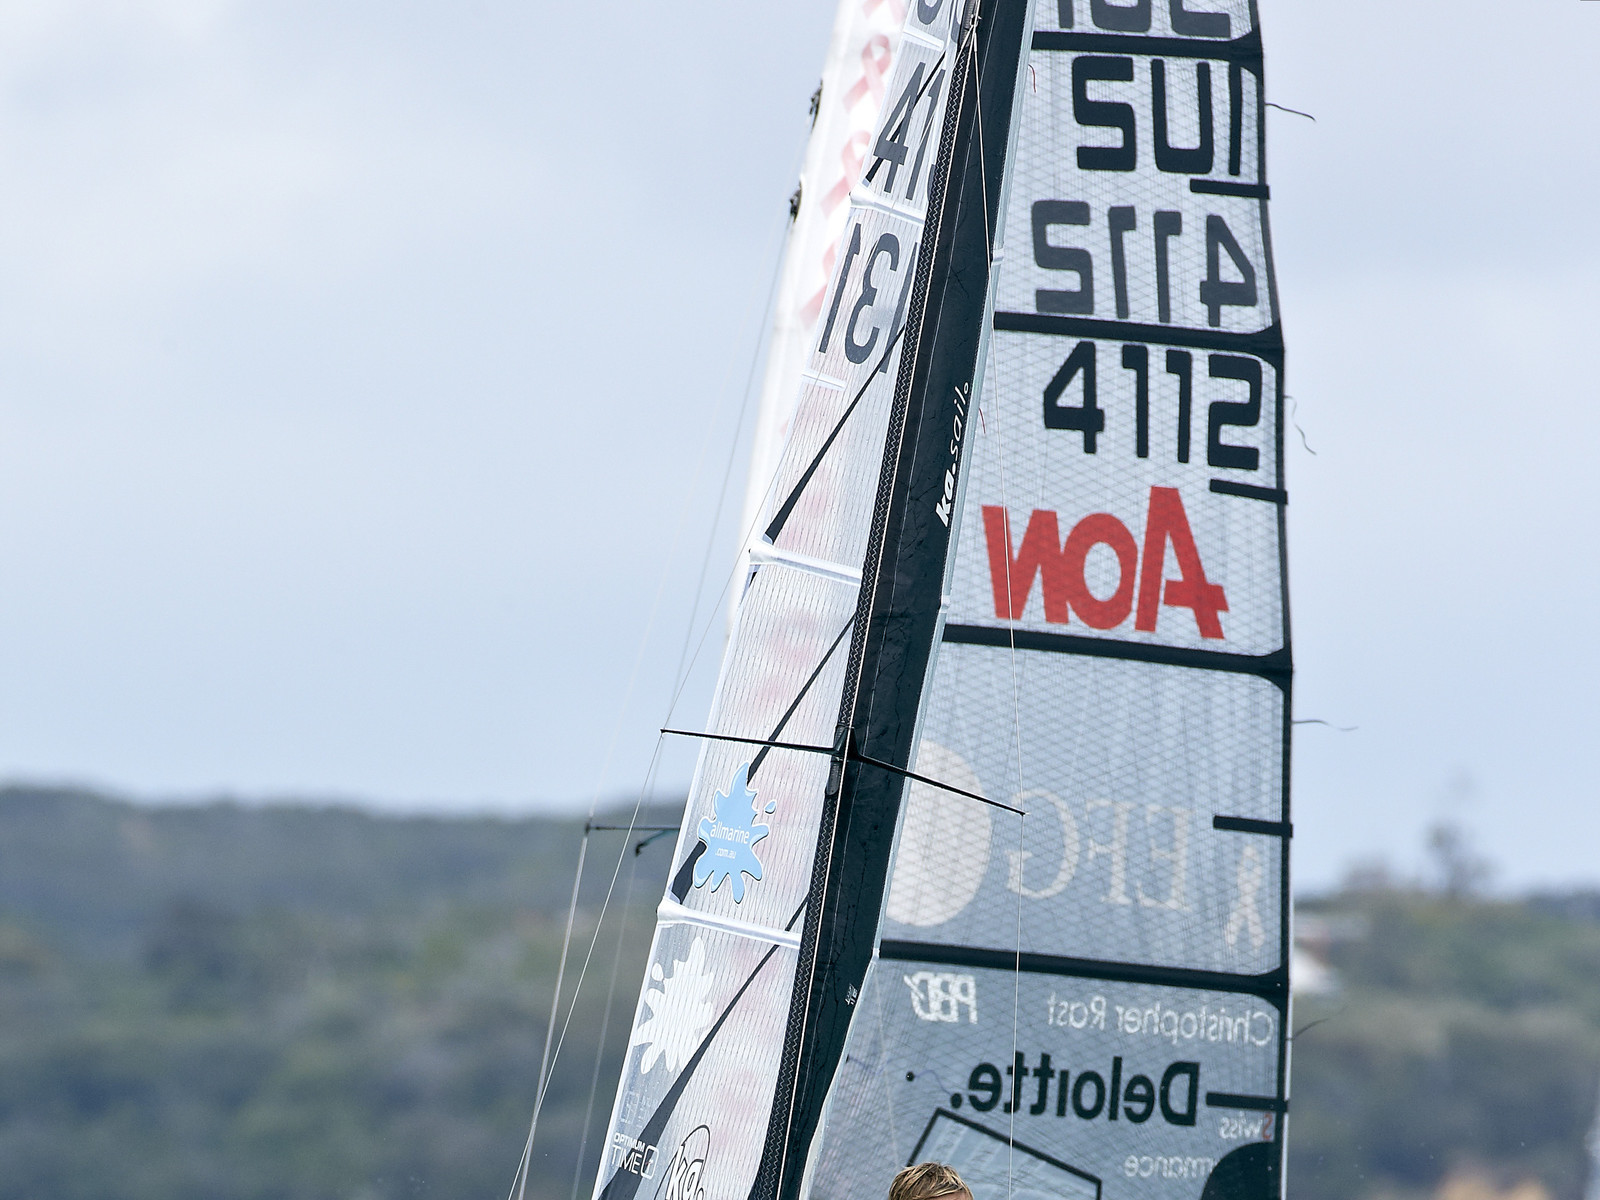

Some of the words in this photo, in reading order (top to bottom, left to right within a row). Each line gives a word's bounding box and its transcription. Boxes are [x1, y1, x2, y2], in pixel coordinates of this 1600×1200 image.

[1072, 55, 1242, 177] SUI
[1043, 340, 1263, 472] 4112
[710, 821, 750, 844] allmarine
[614, 1132, 646, 1153] OPTIMUM
[611, 1144, 643, 1175] TIME
